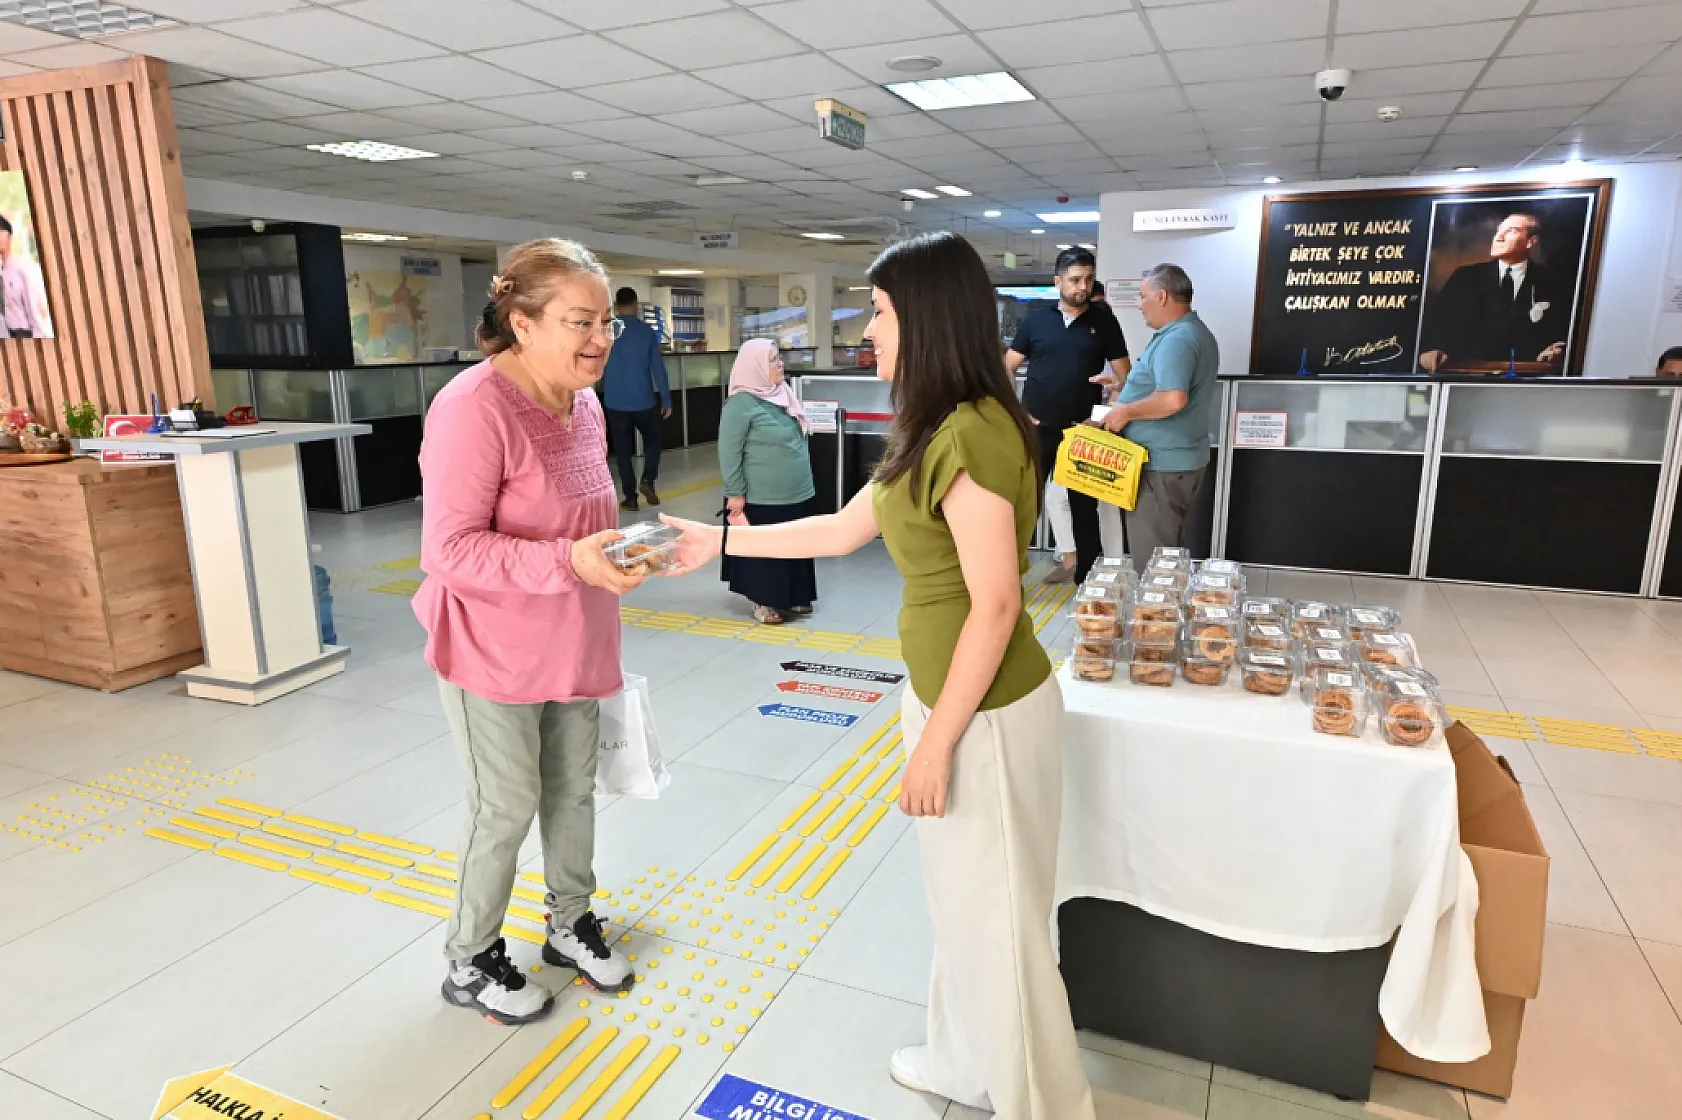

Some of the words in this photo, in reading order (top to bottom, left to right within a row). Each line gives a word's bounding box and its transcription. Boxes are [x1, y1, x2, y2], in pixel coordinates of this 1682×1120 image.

[1343, 221, 1360, 236] VE
[1364, 219, 1412, 235] ANCAK
[1290, 243, 1332, 262] BİRTEK
[1337, 245, 1369, 265] ŞEYE
[1375, 245, 1406, 263] ÇOK
[1285, 268, 1362, 287] İHTİYACIMIZ
[1284, 294, 1350, 314] ÇALIŞKAN
[193, 1086, 265, 1120] HALKLA
[750, 1090, 818, 1120] BİLGİ
